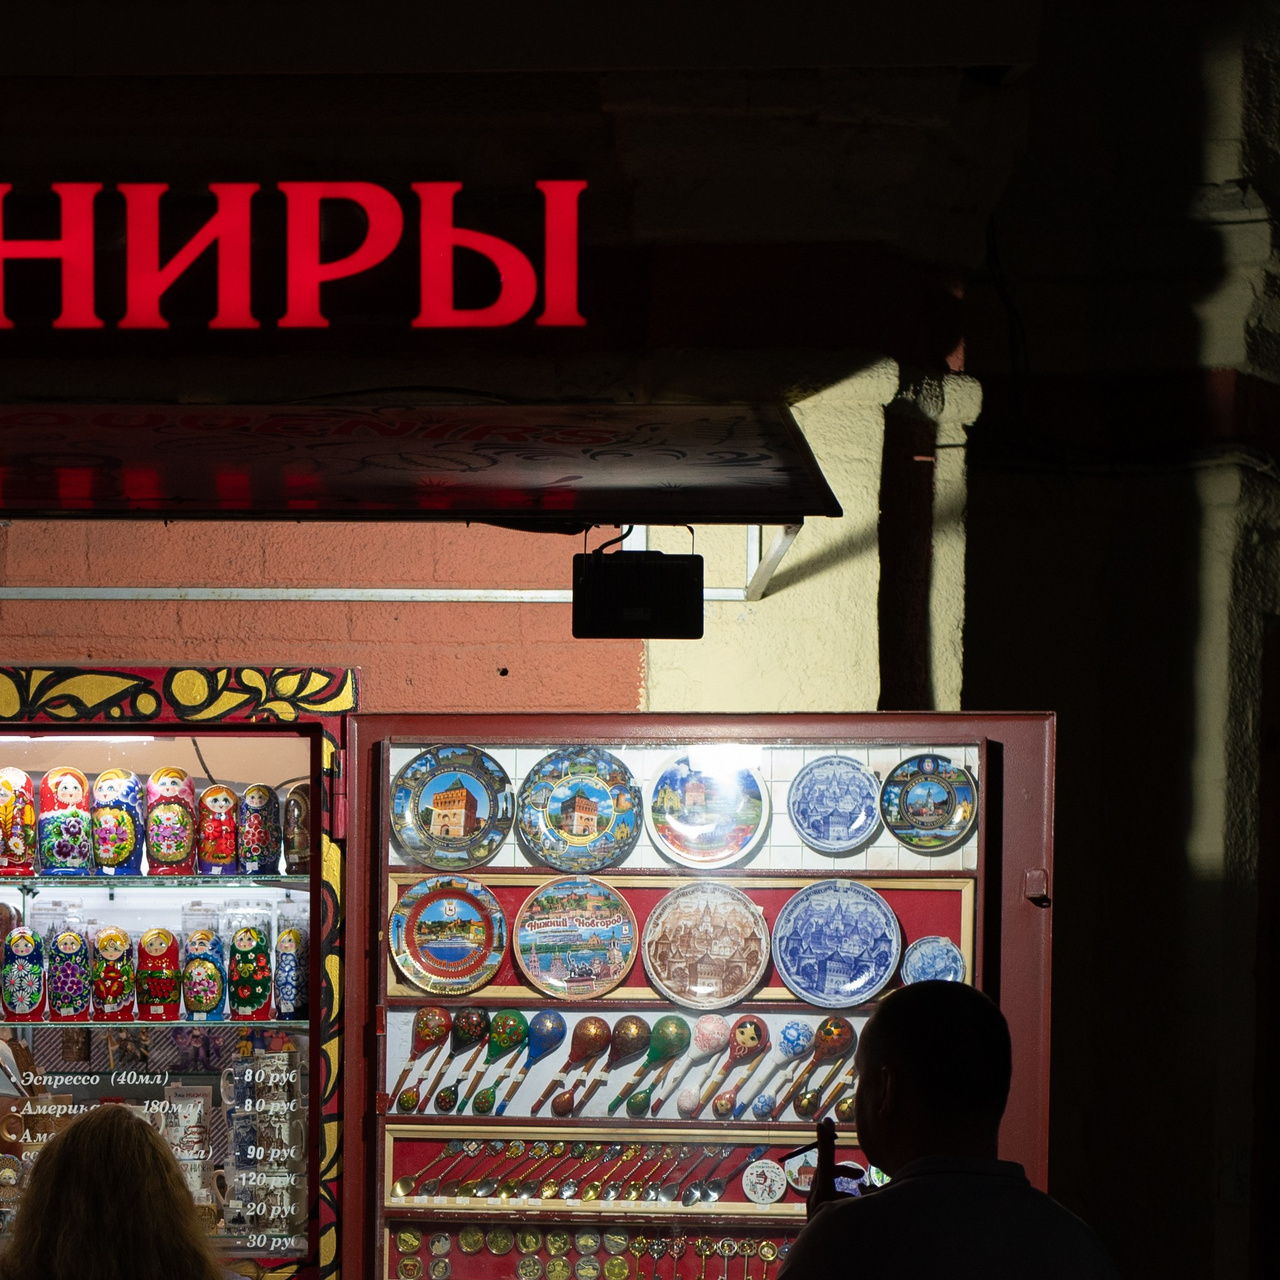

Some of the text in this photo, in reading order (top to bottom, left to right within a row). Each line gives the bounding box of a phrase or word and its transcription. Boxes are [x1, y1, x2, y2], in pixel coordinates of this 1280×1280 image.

[526, 914, 622, 931] Нижний Новгород
[21, 1071, 100, 1088] Эспрессо
[110, 1071, 169, 1087] (40мл)
[244, 1069, 265, 1082] 80
[244, 1098, 265, 1112] 80
[247, 1146, 265, 1160] 90
[246, 1202, 266, 1216] 20
[246, 1234, 267, 1248] 30
